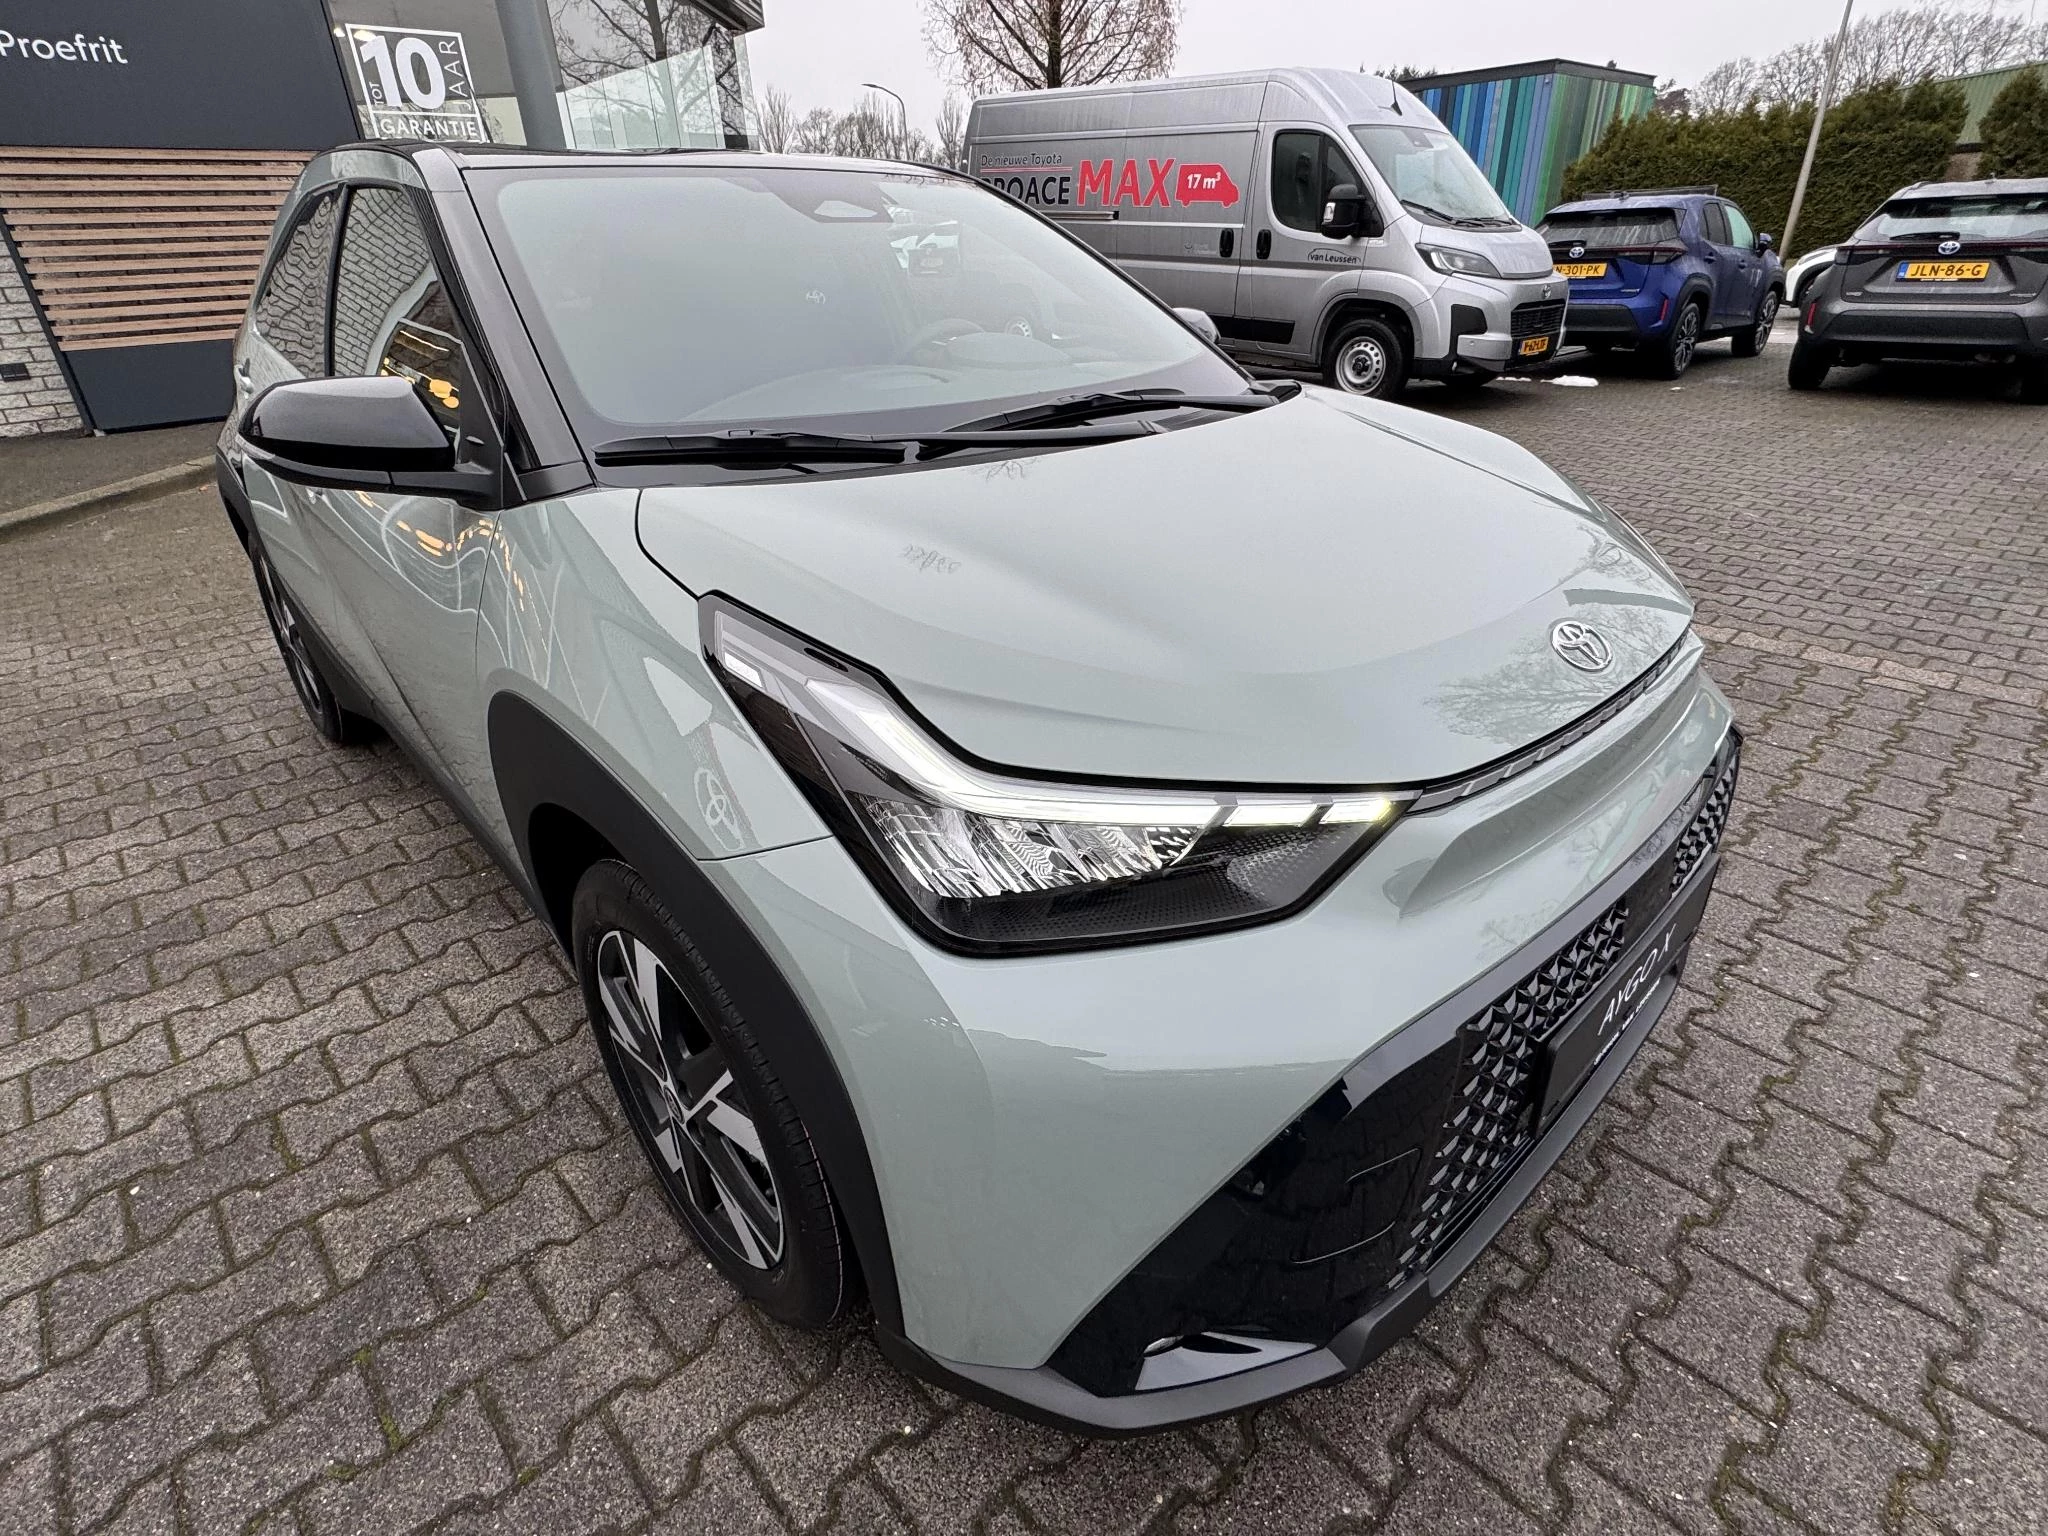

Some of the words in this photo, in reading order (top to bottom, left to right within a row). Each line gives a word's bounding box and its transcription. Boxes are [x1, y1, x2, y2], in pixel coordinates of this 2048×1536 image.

[0, 29, 128, 64] Proefrit
[360, 35, 446, 110] 10
[439, 40, 472, 110] JAAR
[369, 82, 385, 106] TOT
[380, 118, 477, 137] GARANTIE
[981, 154, 993, 167] De
[995, 155, 1028, 166] nieuwe
[1031, 153, 1062, 168] Toyota
[1077, 158, 1176, 207] MAX
[1187, 174, 1201, 189] 17
[1310, 254, 1323, 262] van
[1325, 253, 1357, 264] Leussen
[1911, 264, 1983, 277] JLN-86-G
[1597, 948, 1658, 1036] AYGO
